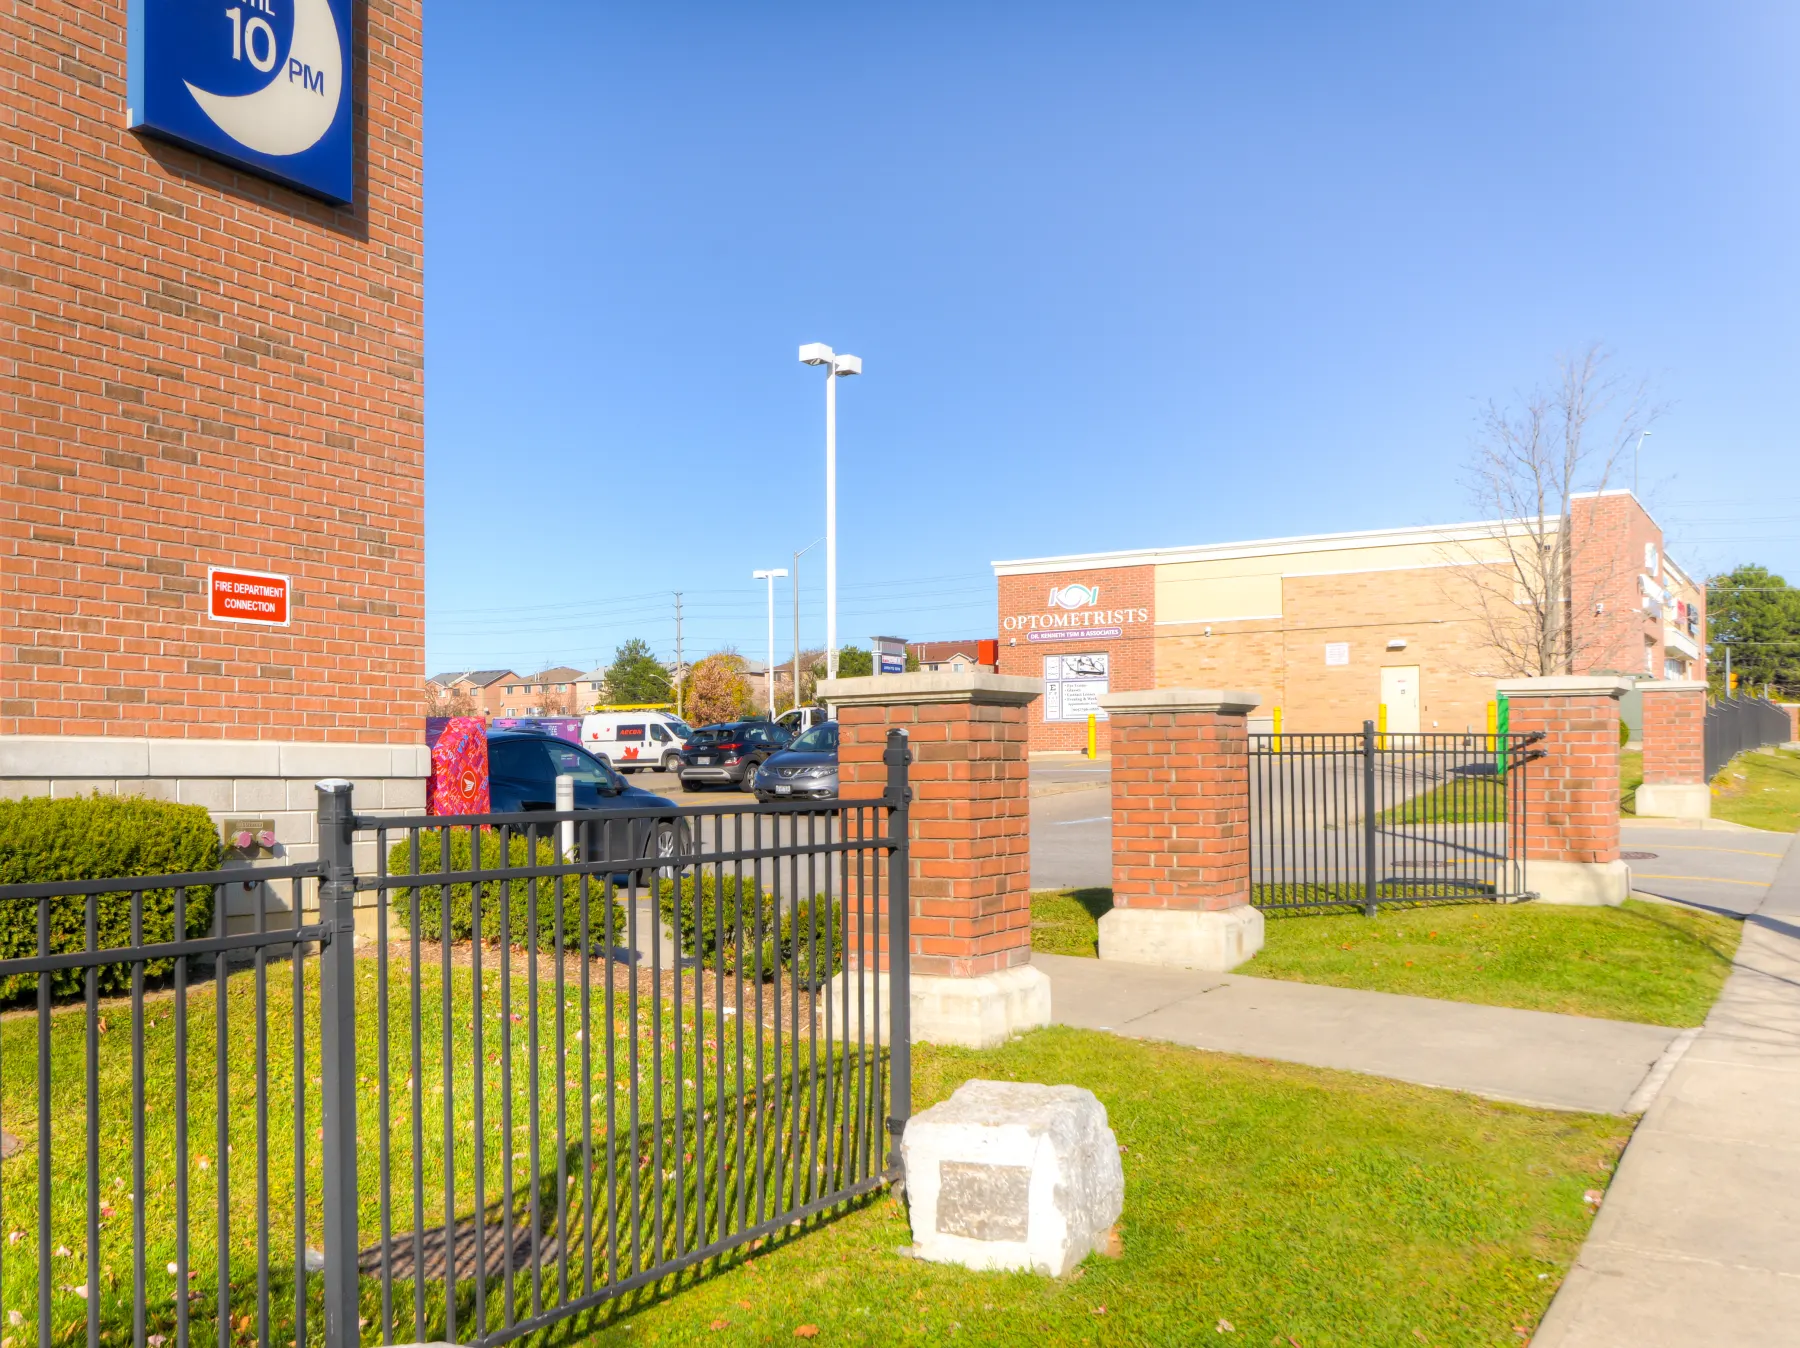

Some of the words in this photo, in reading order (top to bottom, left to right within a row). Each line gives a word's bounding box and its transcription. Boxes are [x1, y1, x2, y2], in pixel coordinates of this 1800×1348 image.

[226, 7, 277, 73] 10
[289, 57, 324, 97] PM
[214, 580, 233, 593] FIRE
[234, 582, 284, 598] DEPARTMENT
[224, 598, 275, 613] CONNECTION
[1003, 608, 1148, 630] OPTOMETRISTS
[1086, 629, 1119, 637] ASSOCIATES
